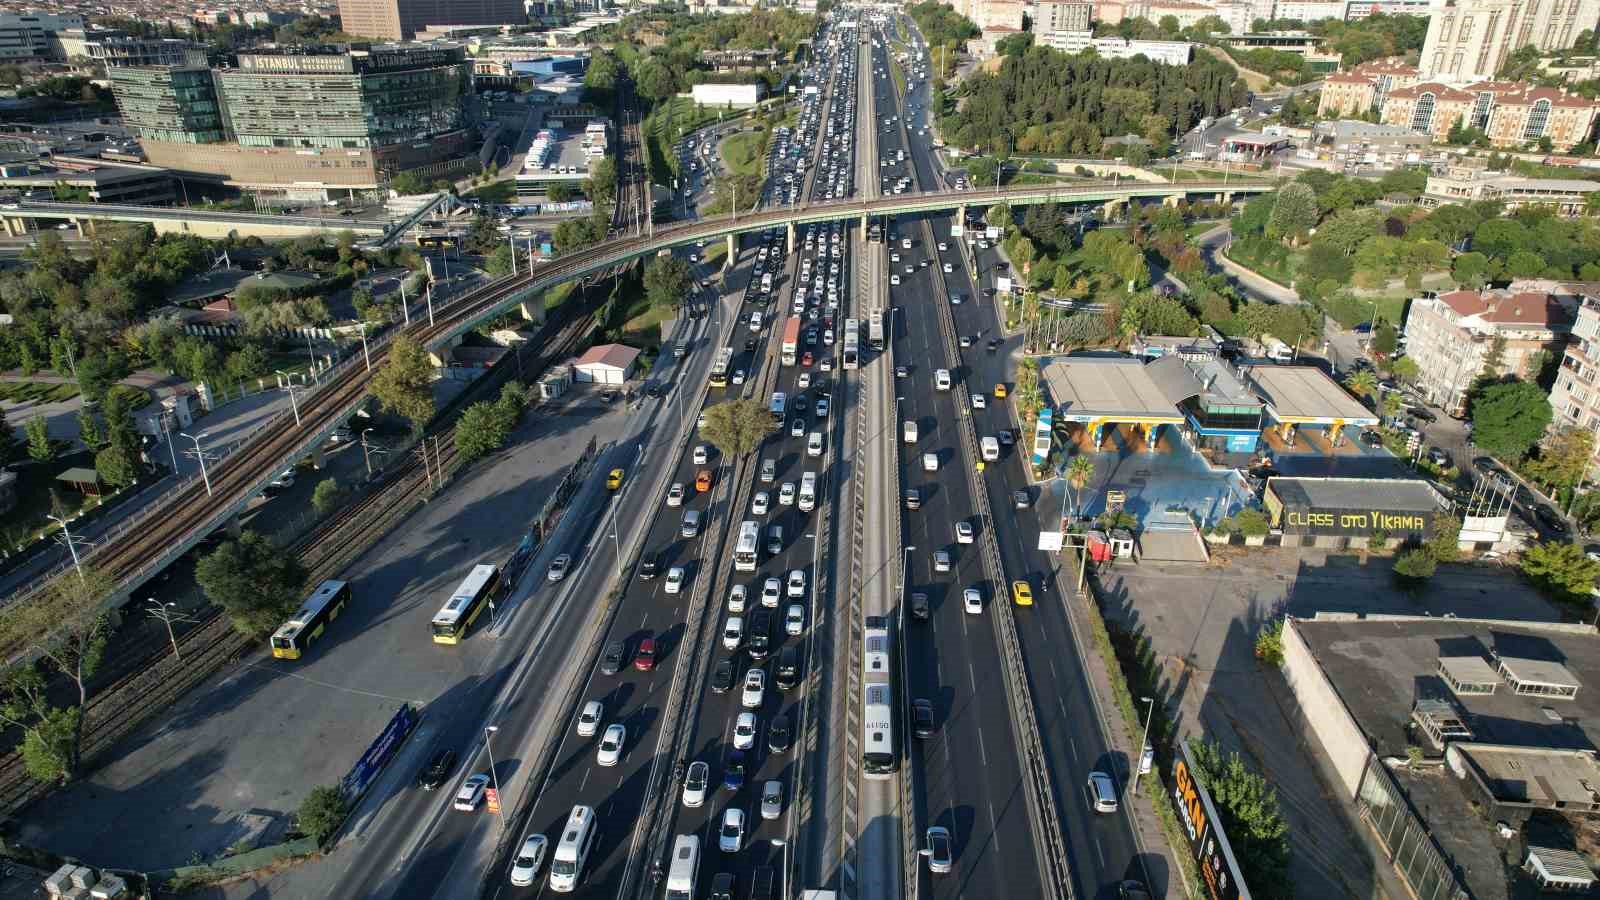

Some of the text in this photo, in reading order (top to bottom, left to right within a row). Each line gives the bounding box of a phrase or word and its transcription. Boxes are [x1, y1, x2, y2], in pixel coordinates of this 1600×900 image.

[1288, 511, 1424, 529] CLASS OTO YIKAMA
[1176, 761, 1206, 840] GKN
